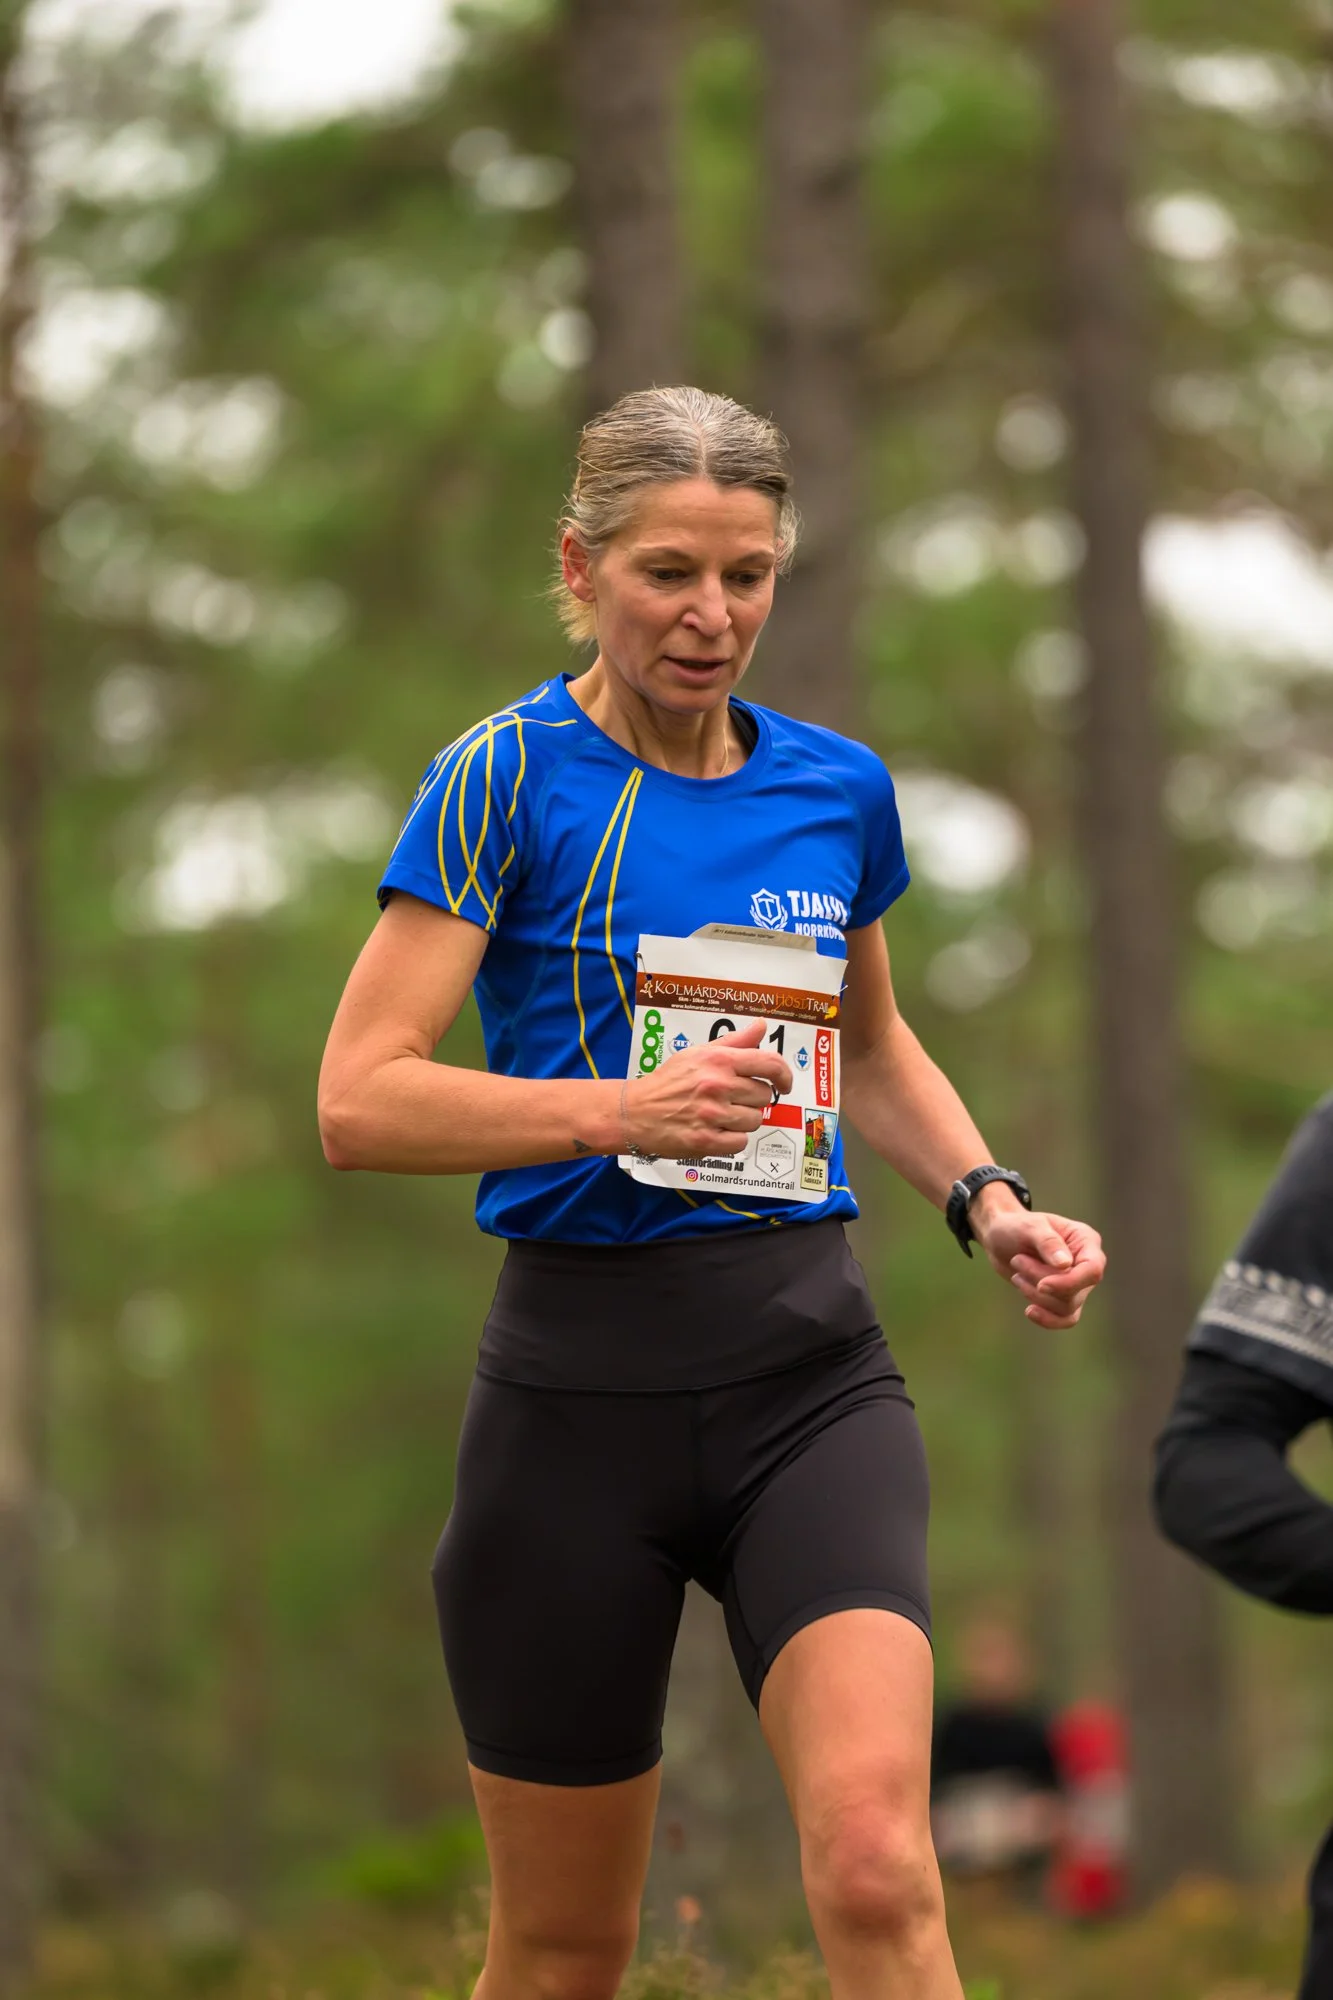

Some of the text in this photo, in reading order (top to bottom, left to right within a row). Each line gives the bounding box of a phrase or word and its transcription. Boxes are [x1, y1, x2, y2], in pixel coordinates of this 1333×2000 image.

[820, 1056, 829, 1101] CIRCLE
[734, 1162, 744, 1172] AB
[700, 1172, 795, 1190] kolmardsrundantrail
